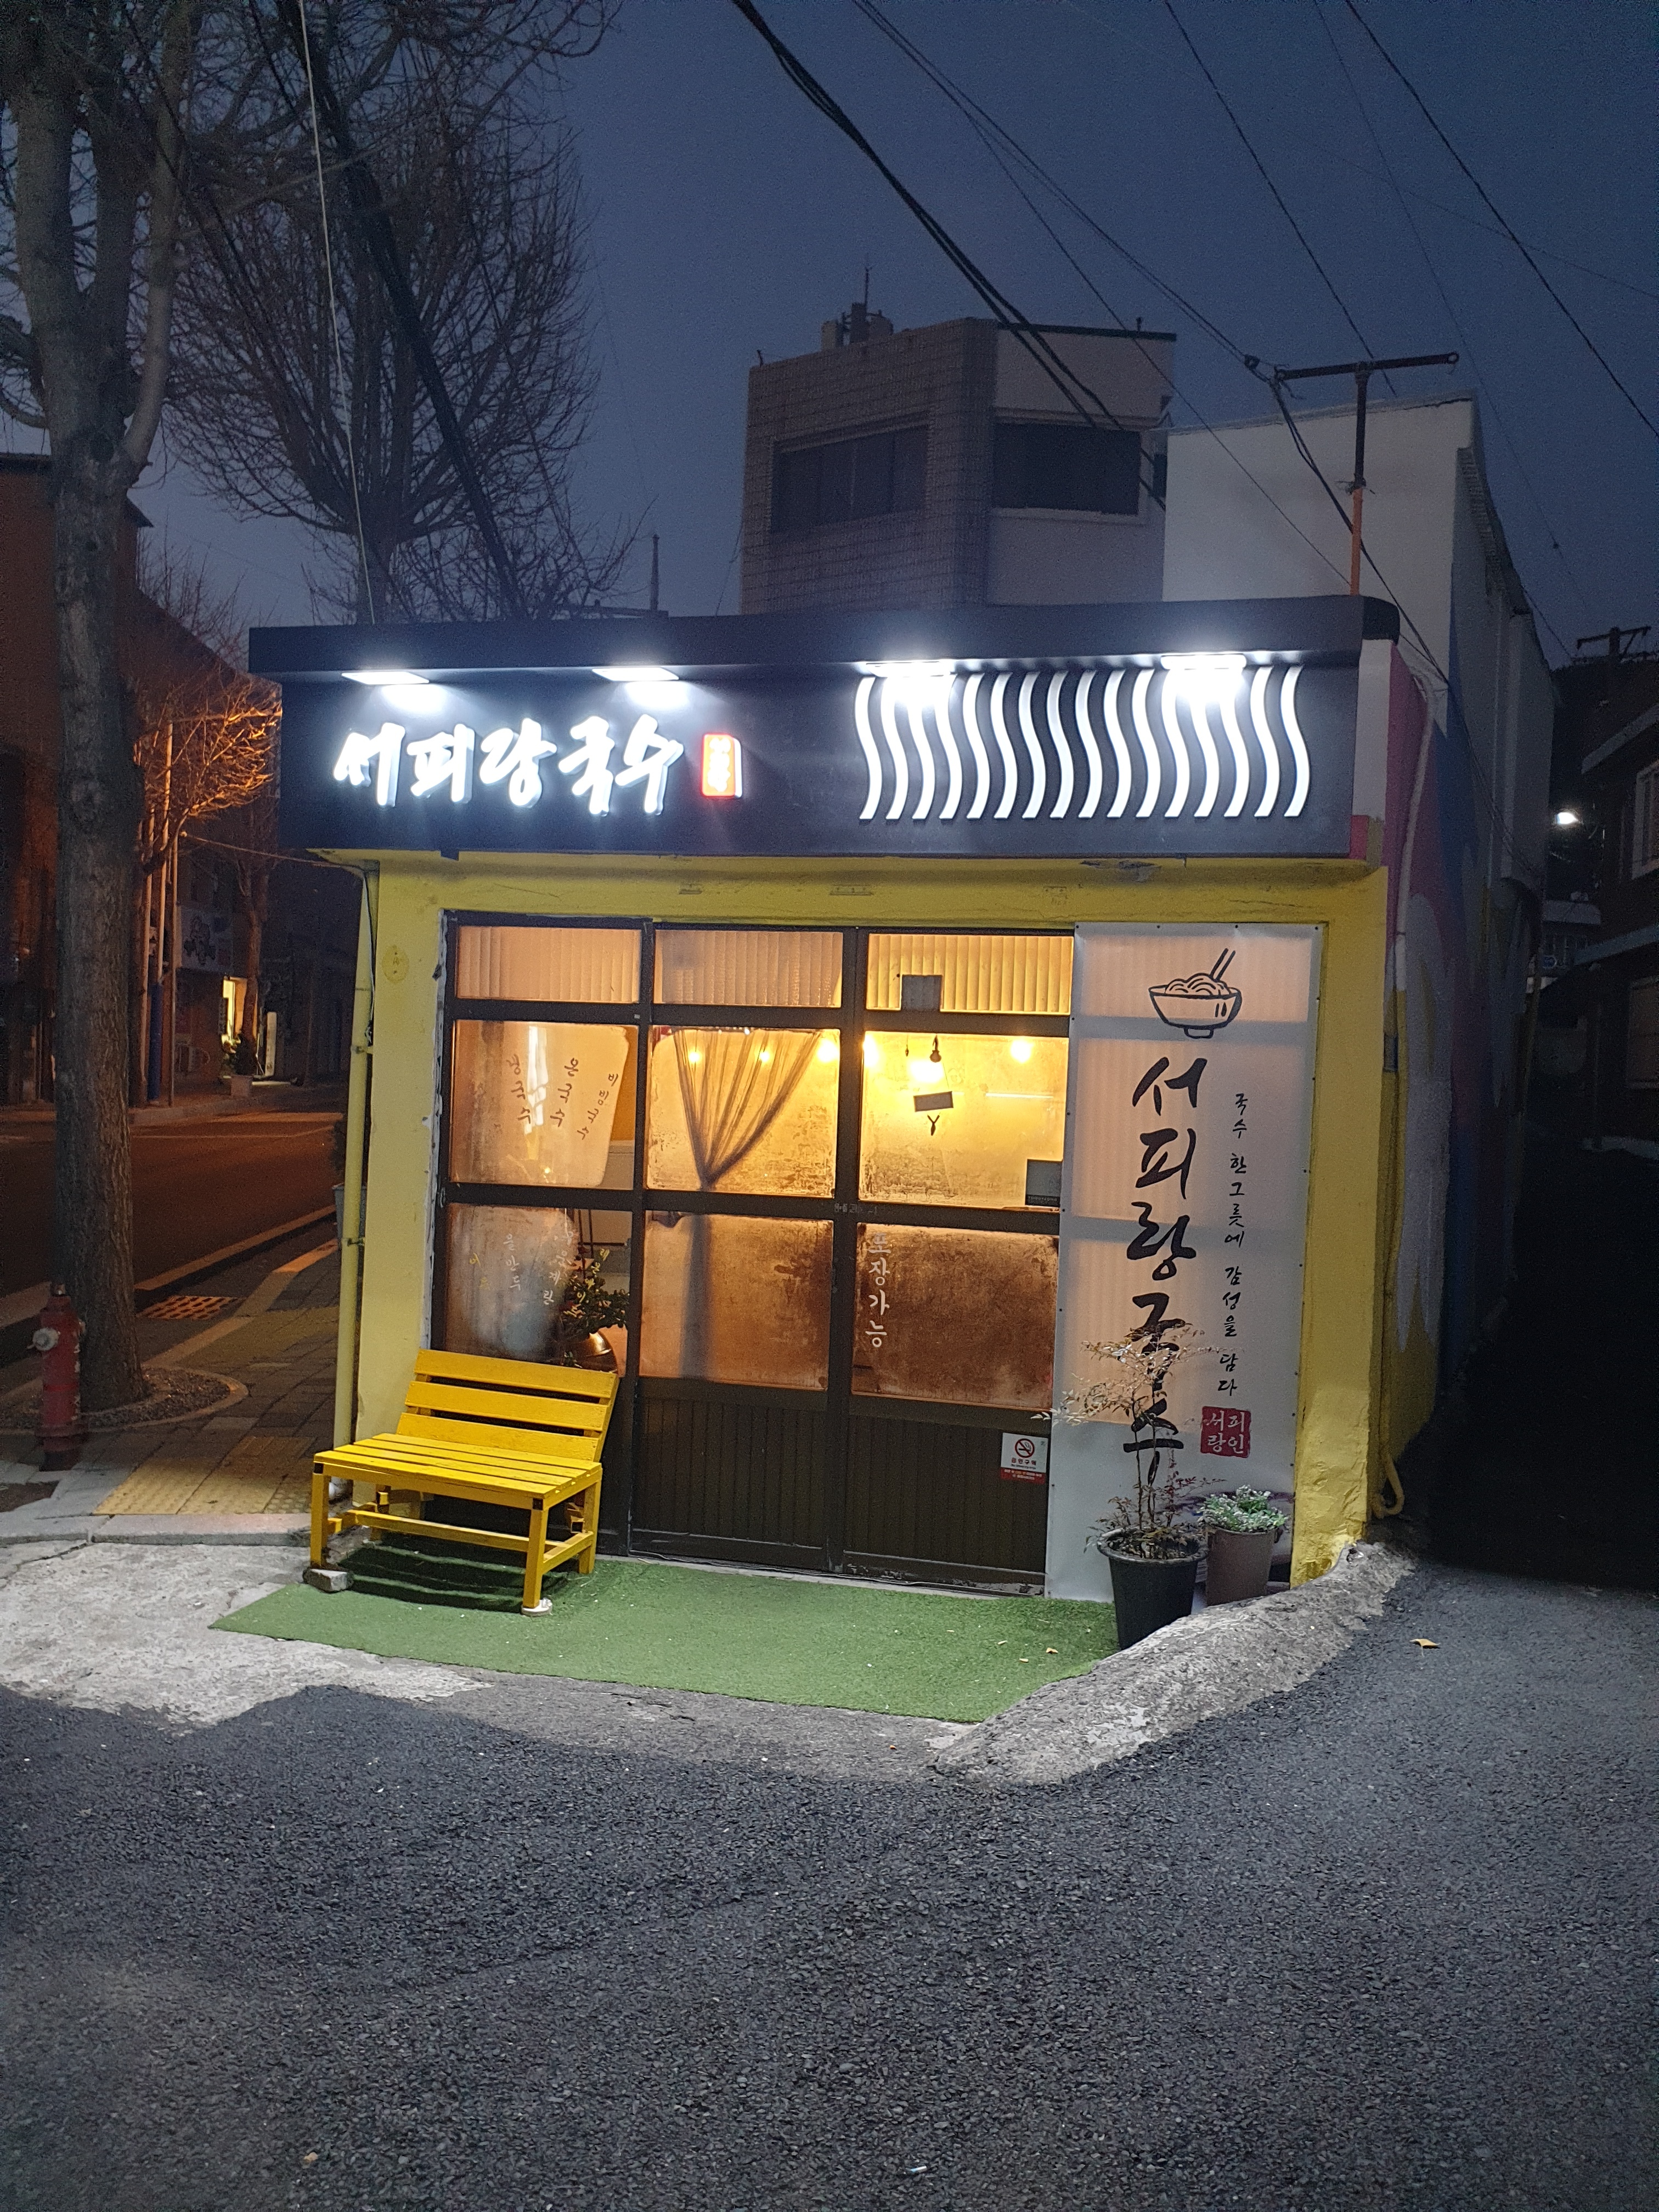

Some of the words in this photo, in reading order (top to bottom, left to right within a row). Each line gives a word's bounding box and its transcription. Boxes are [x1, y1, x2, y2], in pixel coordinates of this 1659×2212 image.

[333, 714, 684, 816] 서피랑국수
[506, 1053, 531, 1124] 콩국수
[577, 1073, 619, 1140] 비빔국수
[1232, 1093, 1248, 1139] 국수
[865, 1232, 891, 1347] 포장가능
[1123, 1057, 1207, 1485] 서피랑국수
[1222, 1265, 1242, 1337] 감성을
[1217, 1353, 1239, 1397] 담다
